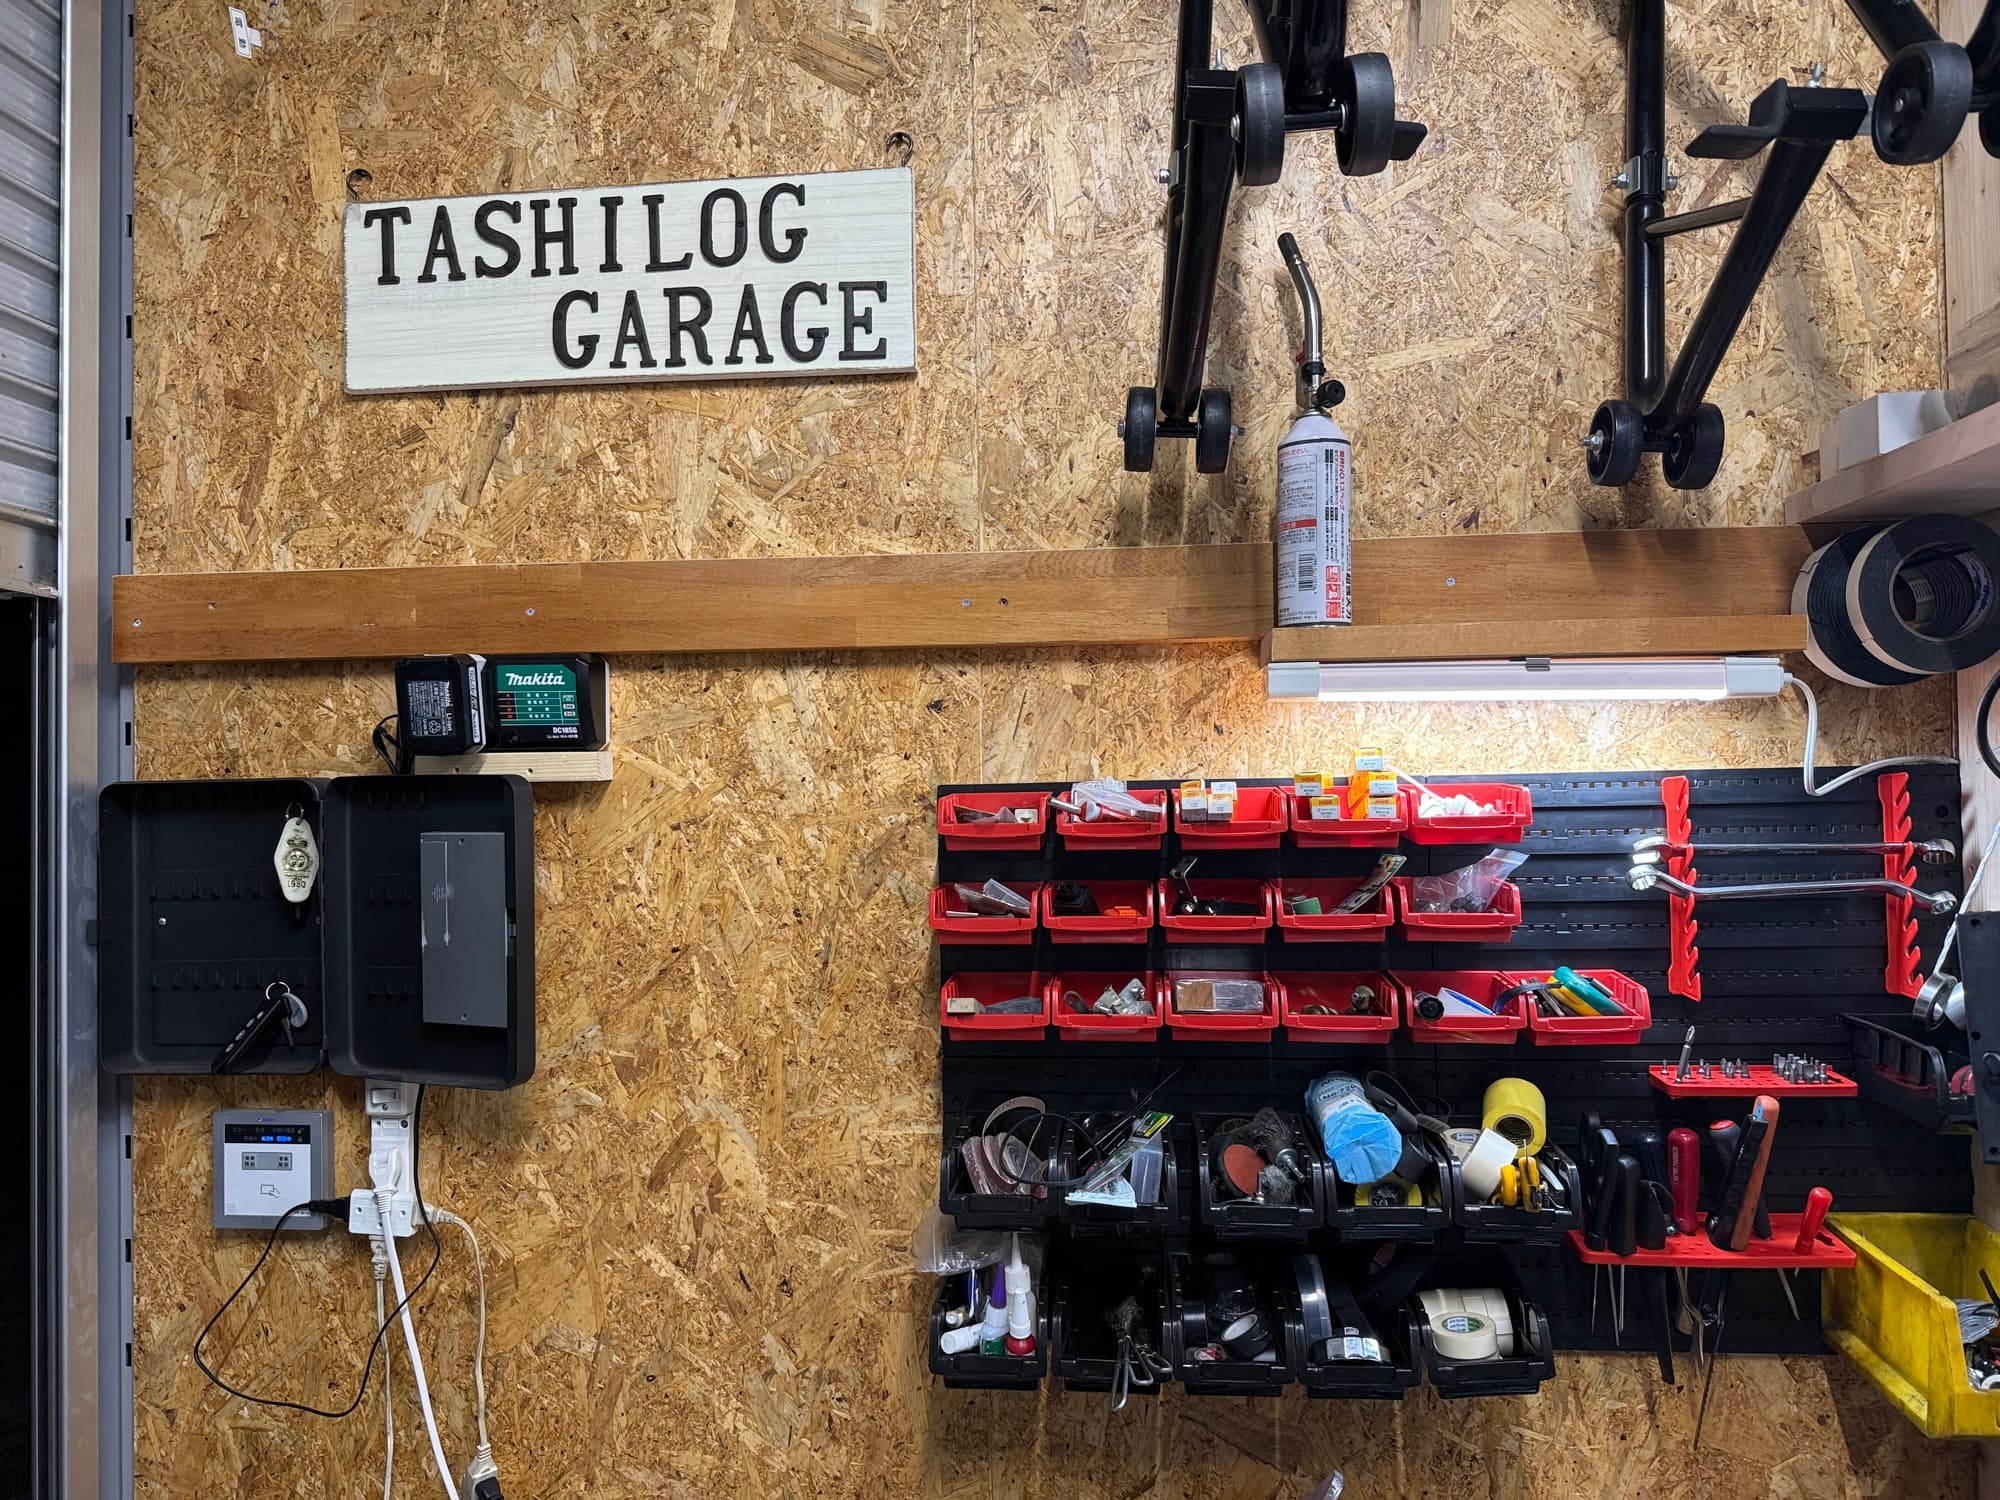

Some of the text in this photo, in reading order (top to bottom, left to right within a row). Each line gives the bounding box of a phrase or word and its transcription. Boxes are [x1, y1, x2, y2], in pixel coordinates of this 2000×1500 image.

[364, 182, 807, 285] TASHILOG
[552, 280, 888, 370] GARAGE
[505, 672, 566, 686] makita
